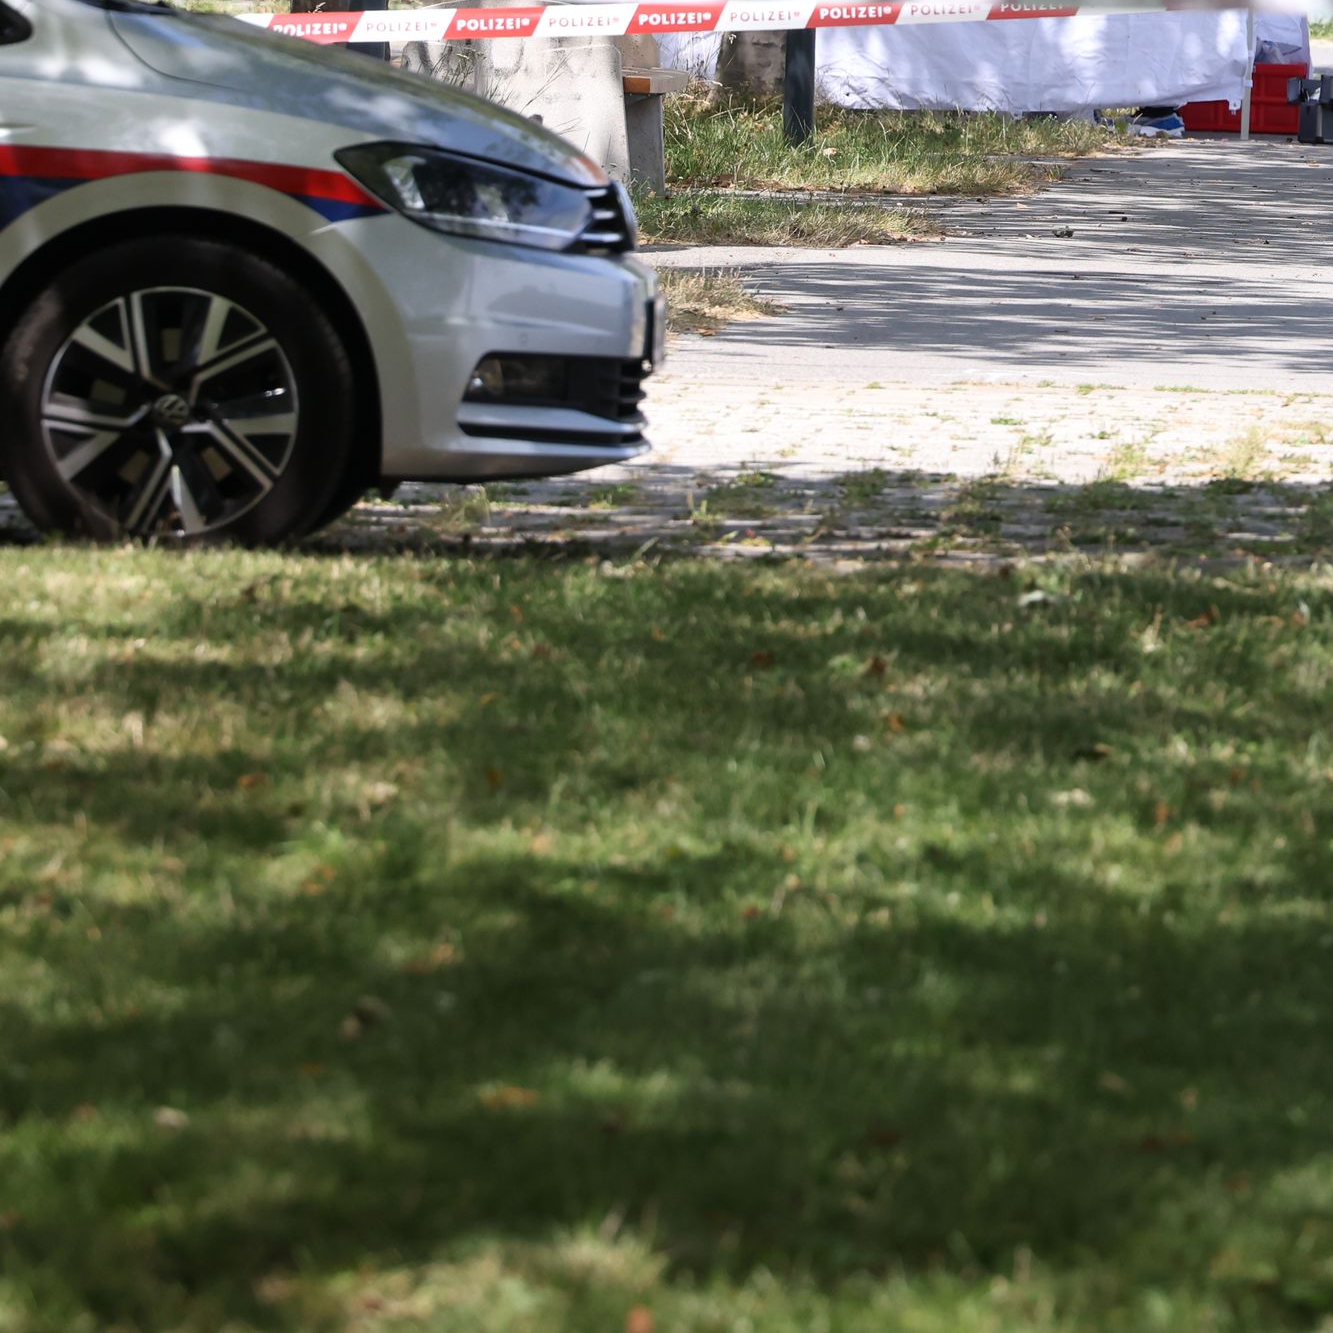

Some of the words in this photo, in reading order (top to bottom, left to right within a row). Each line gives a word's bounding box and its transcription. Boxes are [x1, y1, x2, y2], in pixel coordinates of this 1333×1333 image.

[366, 21, 428, 33] POLIZEI
[456, 18, 521, 32] POLIZEI
[549, 16, 610, 28] POLIZEI
[639, 12, 702, 26] POLIZEI
[730, 10, 791, 22] POLIZEI
[820, 5, 882, 19] POLIZEI
[911, 3, 972, 16] POLIZEI
